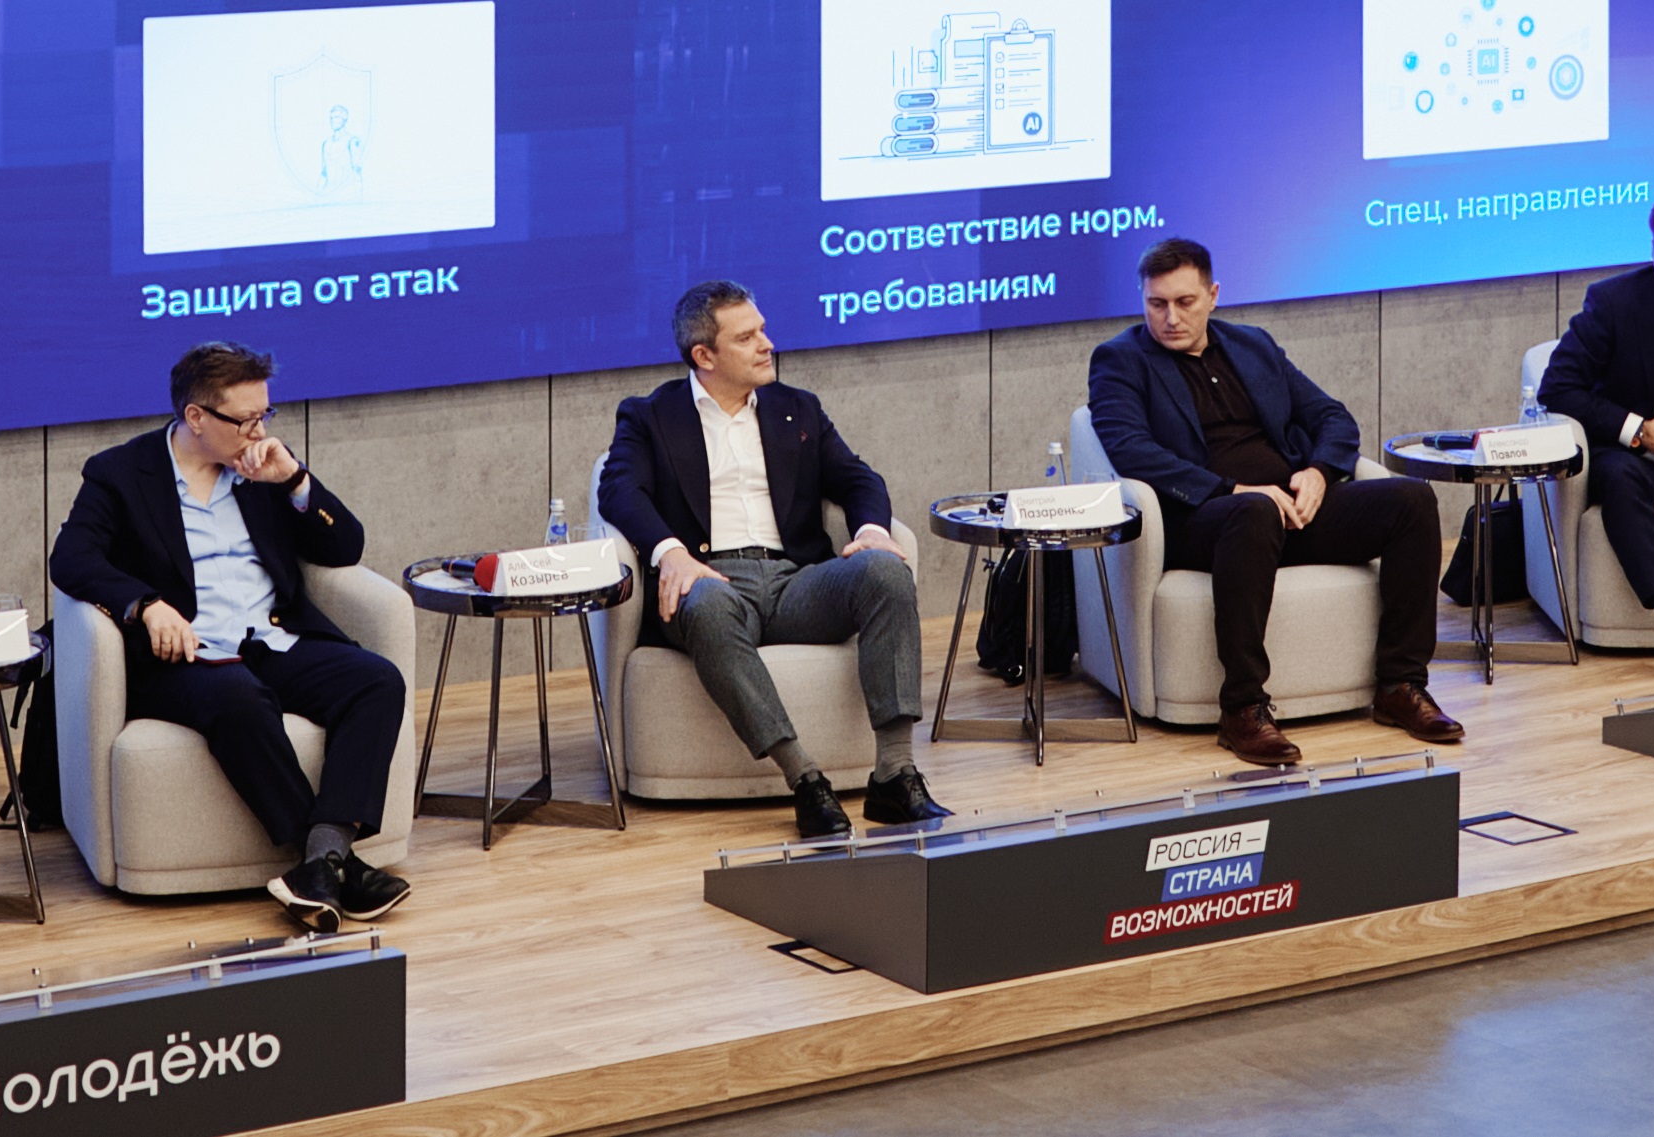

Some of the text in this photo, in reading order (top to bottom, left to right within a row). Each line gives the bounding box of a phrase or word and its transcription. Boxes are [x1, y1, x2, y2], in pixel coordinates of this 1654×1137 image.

[1025, 115, 1040, 131] AI
[1364, 181, 1650, 227] Спец. направления
[820, 205, 1164, 257] Соответствие норм.
[141, 266, 459, 319] Защита от атак
[819, 272, 1056, 324] требованиям
[1490, 449, 1528, 461] Павлов
[508, 557, 552, 571] Алесей
[1154, 831, 1242, 865] РОССИЯ
[1169, 861, 1253, 895] СТРАНА
[1110, 882, 1293, 939] ВОЗМОЖНОСТЕЙ
